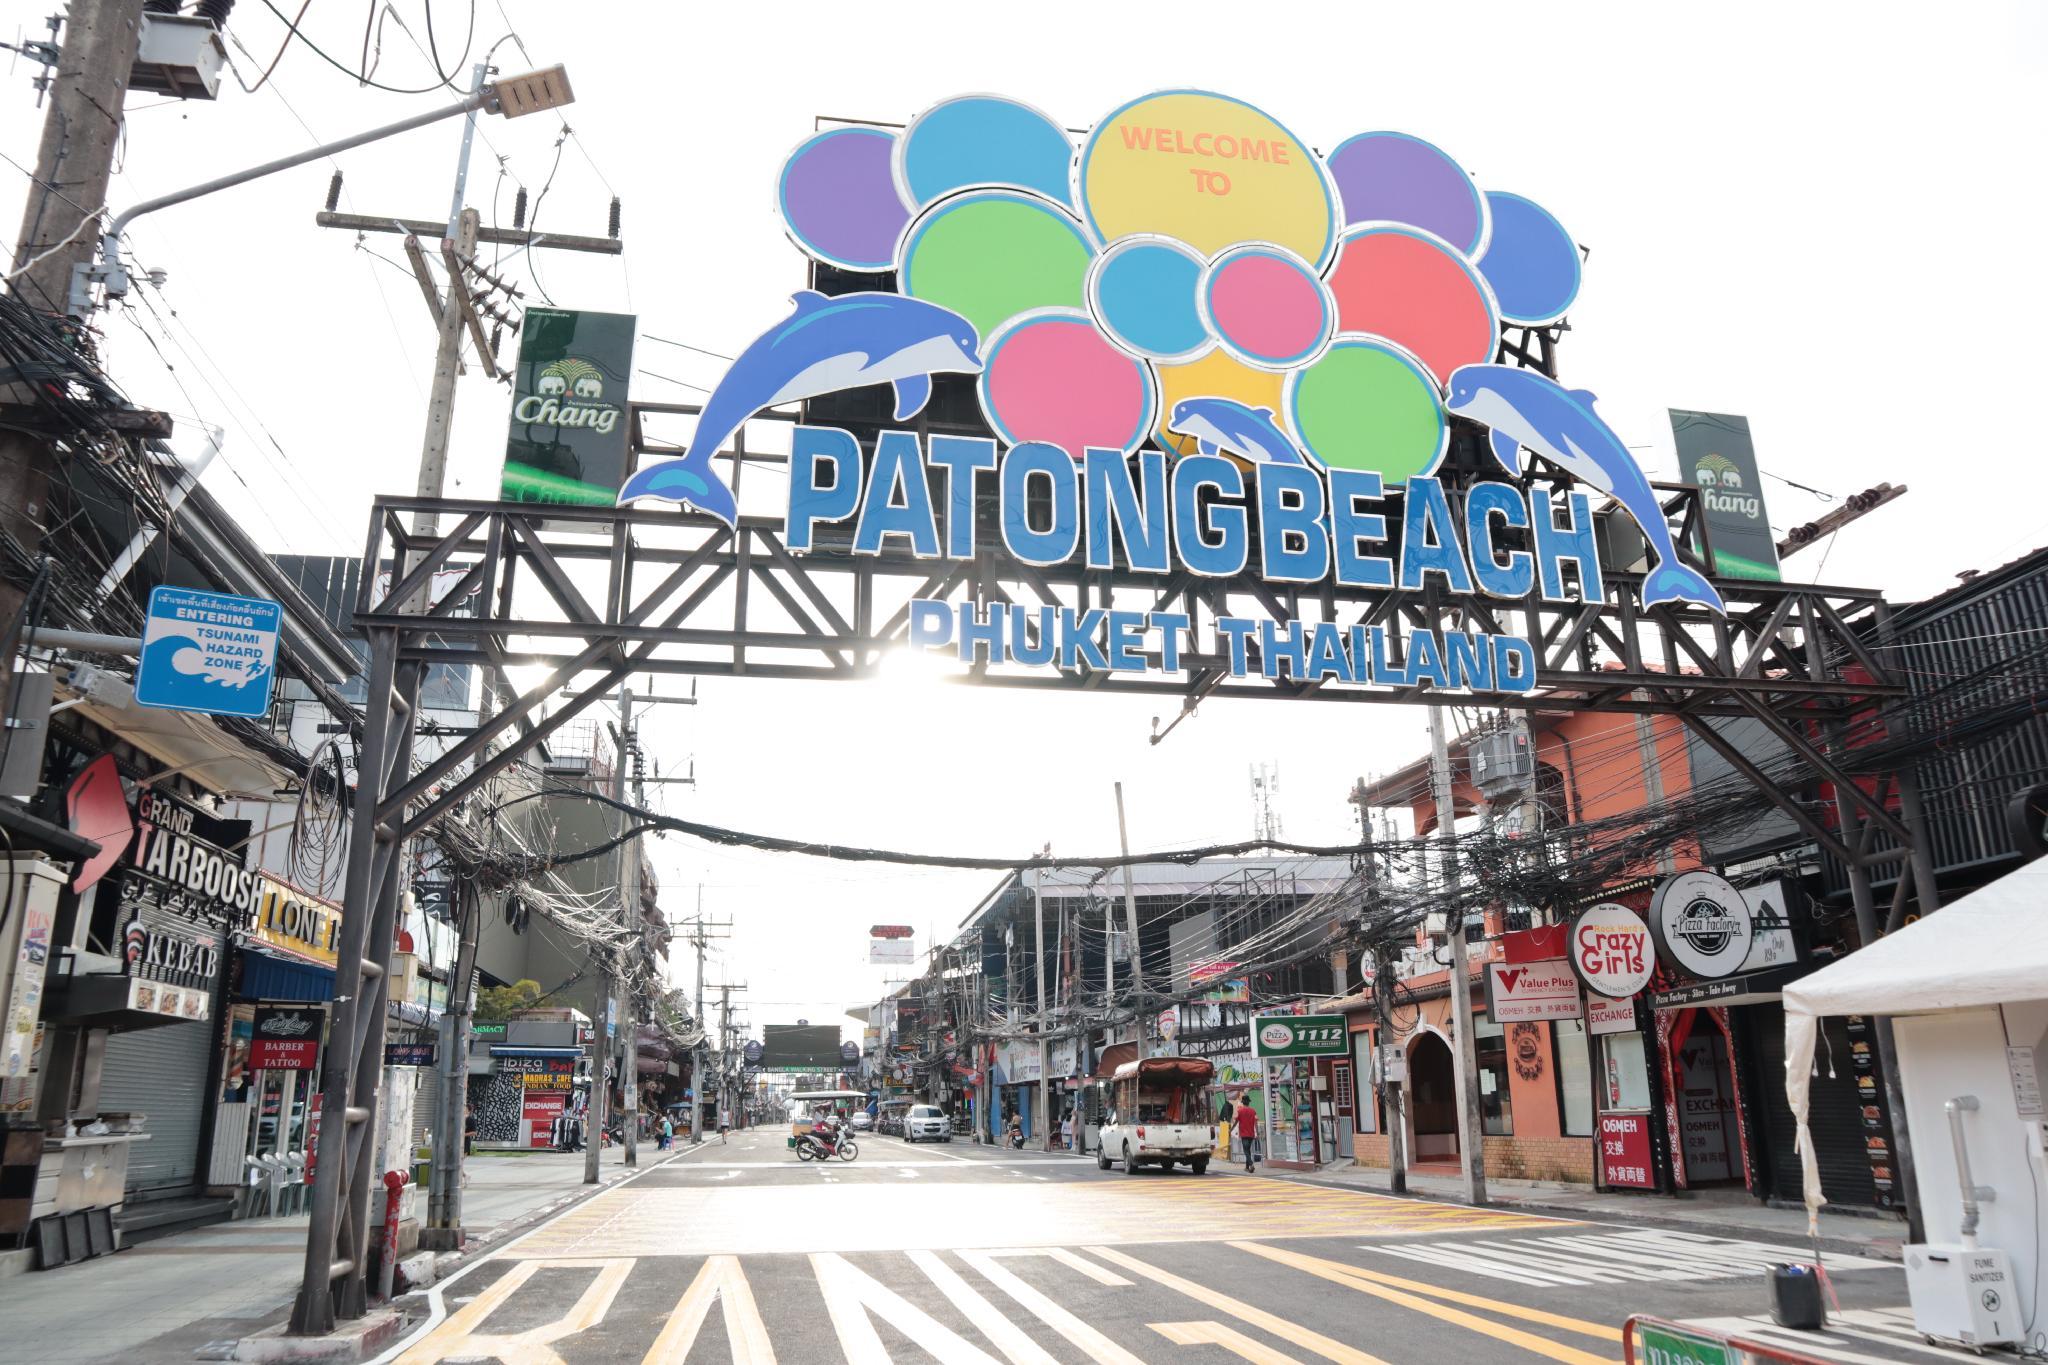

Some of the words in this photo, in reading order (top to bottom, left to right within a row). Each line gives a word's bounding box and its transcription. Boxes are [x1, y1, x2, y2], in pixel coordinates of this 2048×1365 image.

[1120, 125, 1290, 165] WELCOME
[1189, 168, 1232, 196] TO
[514, 396, 621, 434] Chang
[1702, 487, 1760, 520] hang
[176, 607, 254, 627] ENTERING
[197, 627, 260, 645] TSUNAMI
[909, 597, 1191, 674] PHUKET
[1216, 615, 1537, 693] THAILAND
[206, 643, 264, 659] HAZARD
[204, 656, 243, 671] ZONE
[140, 793, 193, 836] GRAND
[135, 819, 266, 917] TARBOOSH
[268, 892, 328, 948] LONE
[1678, 914, 1702, 932] Pizza
[1706, 914, 1736, 932] Factory
[1579, 925, 1645, 959] Crazy
[145, 933, 217, 978] KEBAB
[1582, 947, 1645, 975] Girls
[1520, 978, 1549, 989] Value
[1551, 977, 1574, 988] Plus
[1590, 1007, 1633, 1024] EXCHANGE
[1297, 1028, 1343, 1041] 1112
[264, 1042, 304, 1051] BARBER
[263, 1058, 301, 1067] TATTOO
[503, 1057, 543, 1068] Ibiza
[524, 1073, 553, 1083] MADRAS
[524, 1102, 562, 1110] EXCHANGE
[1974, 1258, 1995, 1269] FUME
[1969, 1271, 2005, 1283] SANITIZER
